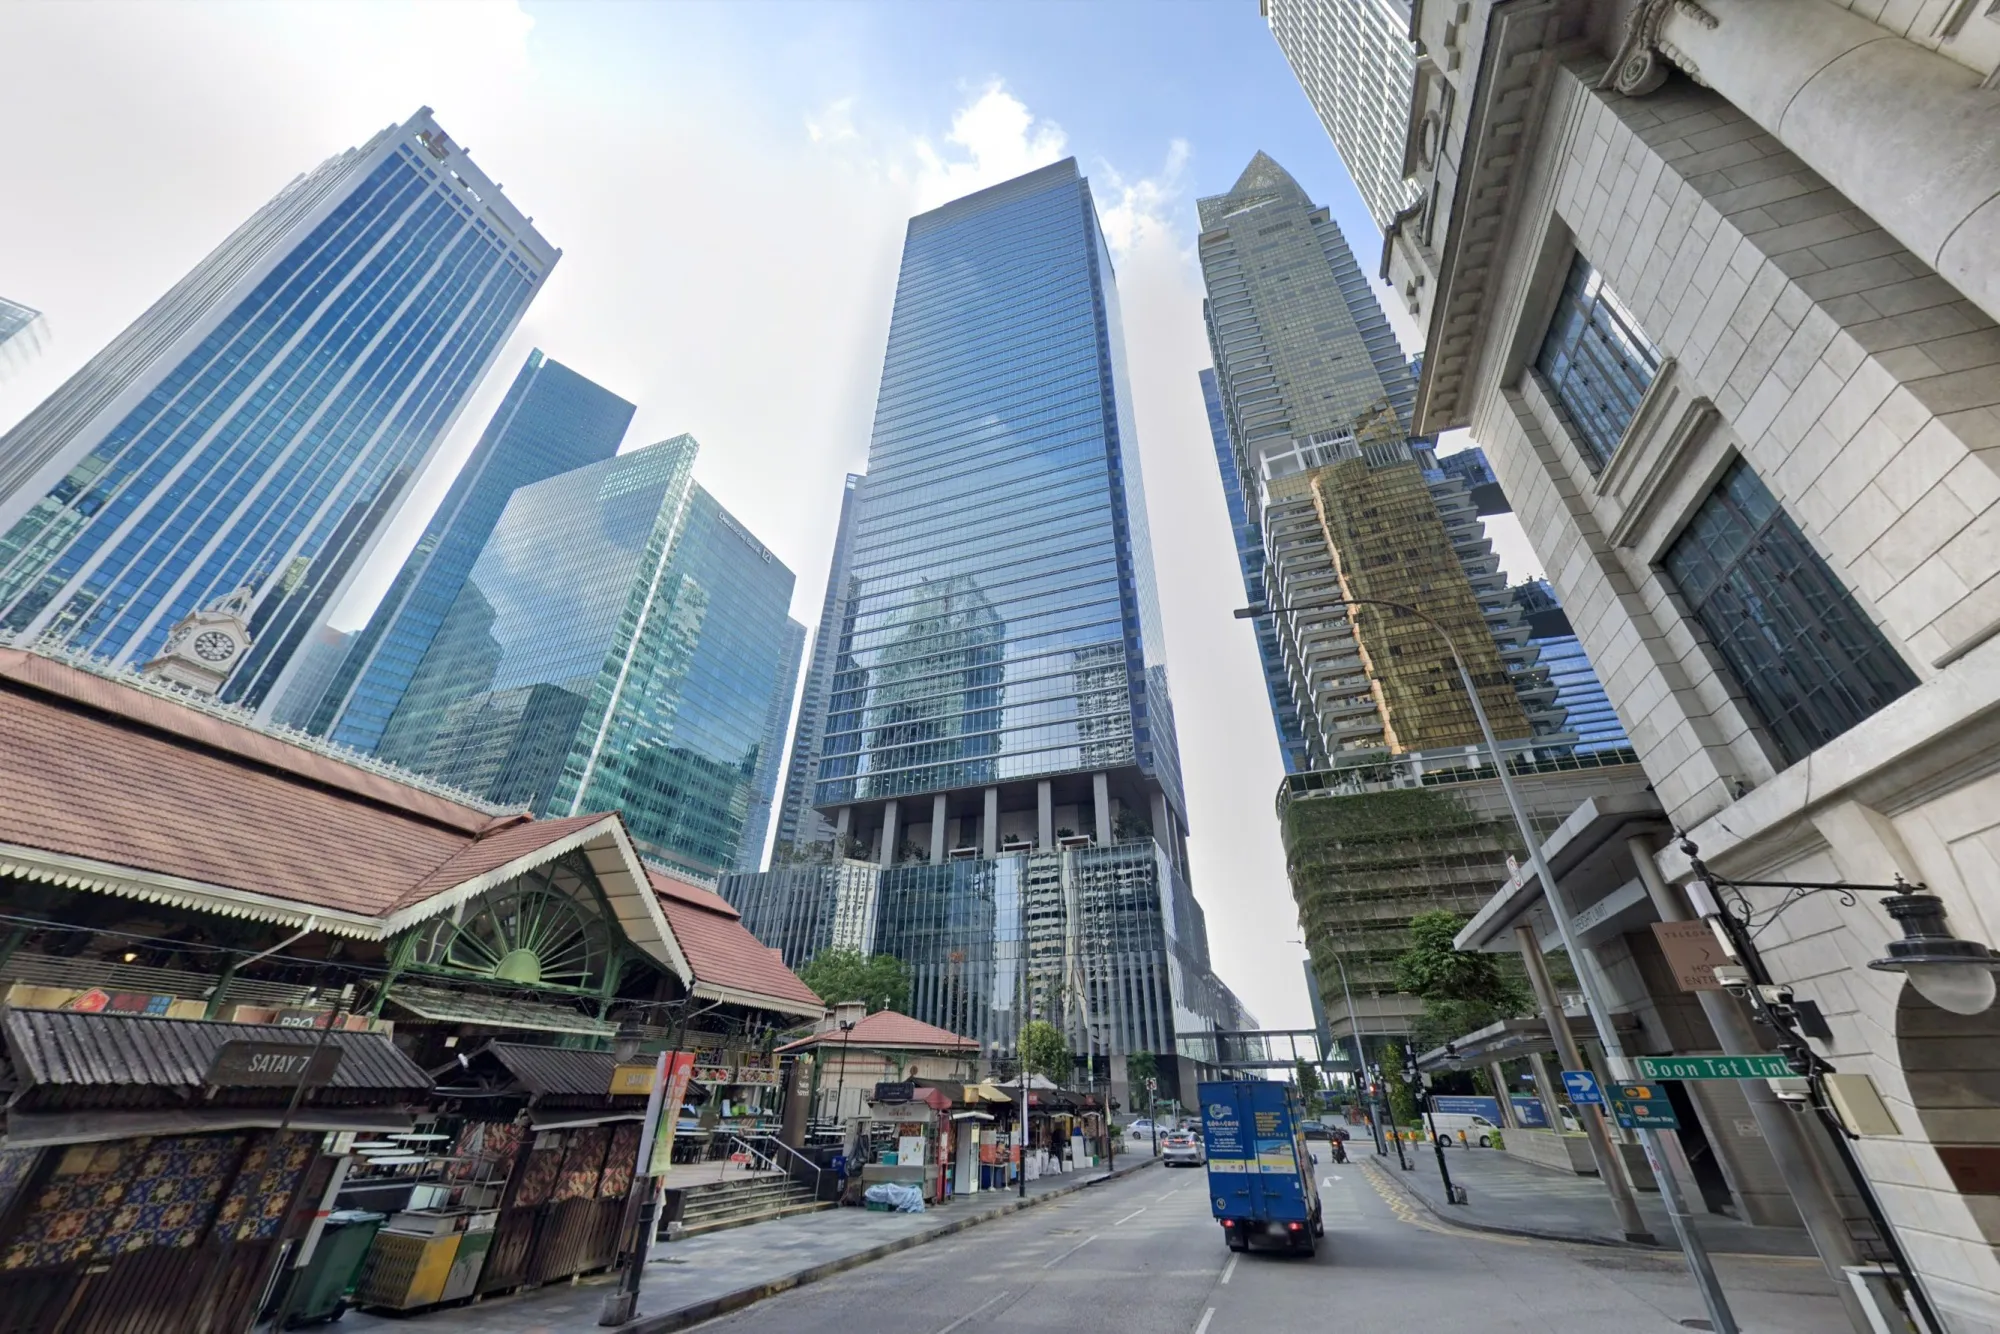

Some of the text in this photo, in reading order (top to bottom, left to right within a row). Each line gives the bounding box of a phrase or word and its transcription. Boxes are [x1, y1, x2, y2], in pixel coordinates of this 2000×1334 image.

[719, 512, 761, 556] Deutsche Bank
[1664, 930, 1715, 938] TELEGRA
[248, 1054, 311, 1073] SATAY 7
[1643, 1058, 1797, 1077] Boon Tat Link
